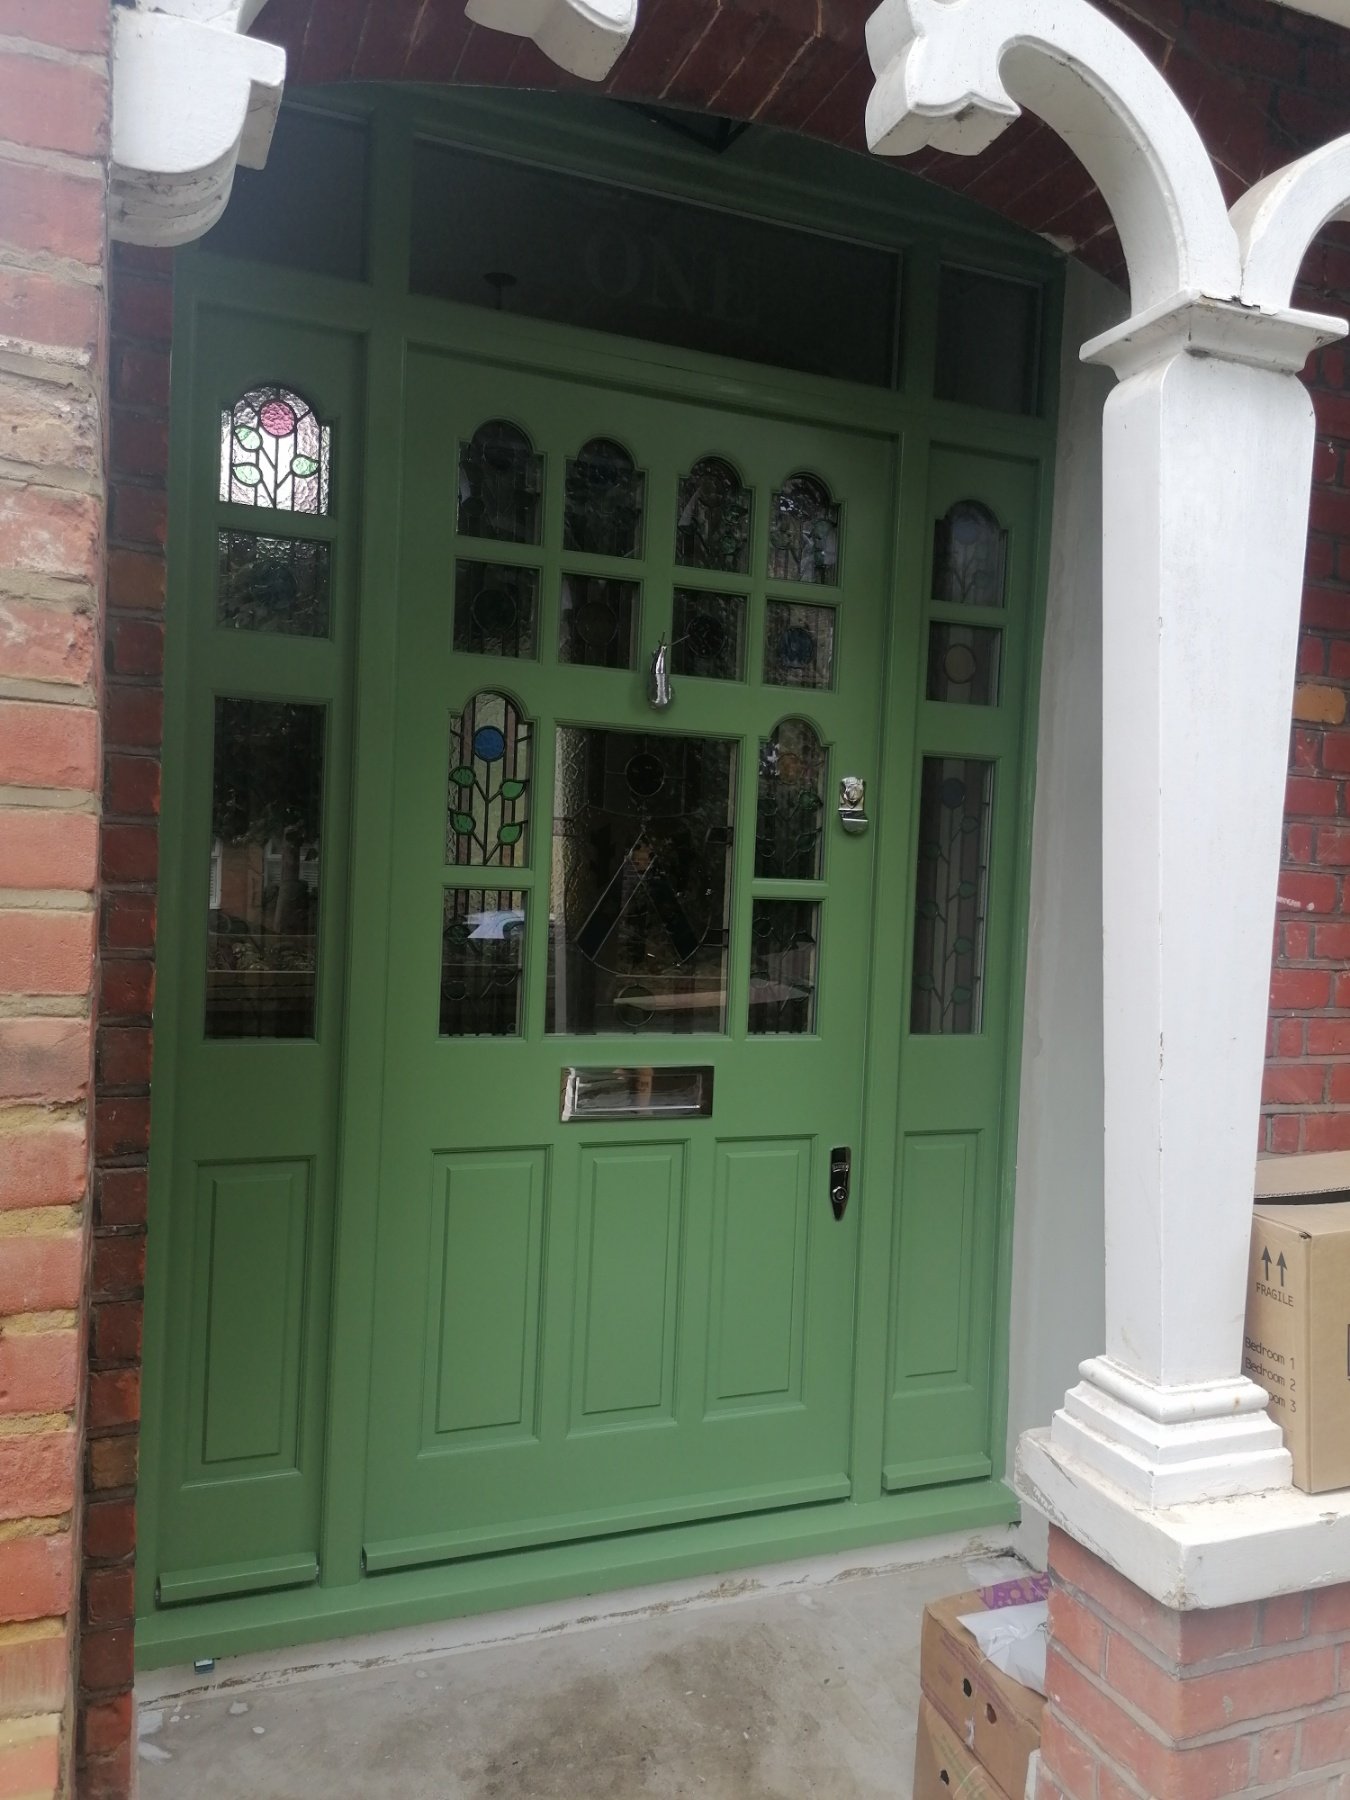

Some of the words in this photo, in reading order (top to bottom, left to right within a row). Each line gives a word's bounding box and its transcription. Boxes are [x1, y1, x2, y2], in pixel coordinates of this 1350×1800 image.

[585, 229, 758, 323] ONE
[1256, 1282, 1294, 1307] FRAGILE
[1245, 1337, 1285, 1365] Bedroom
[1290, 1357, 1296, 1370] 1
[1245, 1357, 1285, 1386] Bedroom
[1290, 1378, 1296, 1392] 2
[1290, 1399, 1296, 1413] 3
